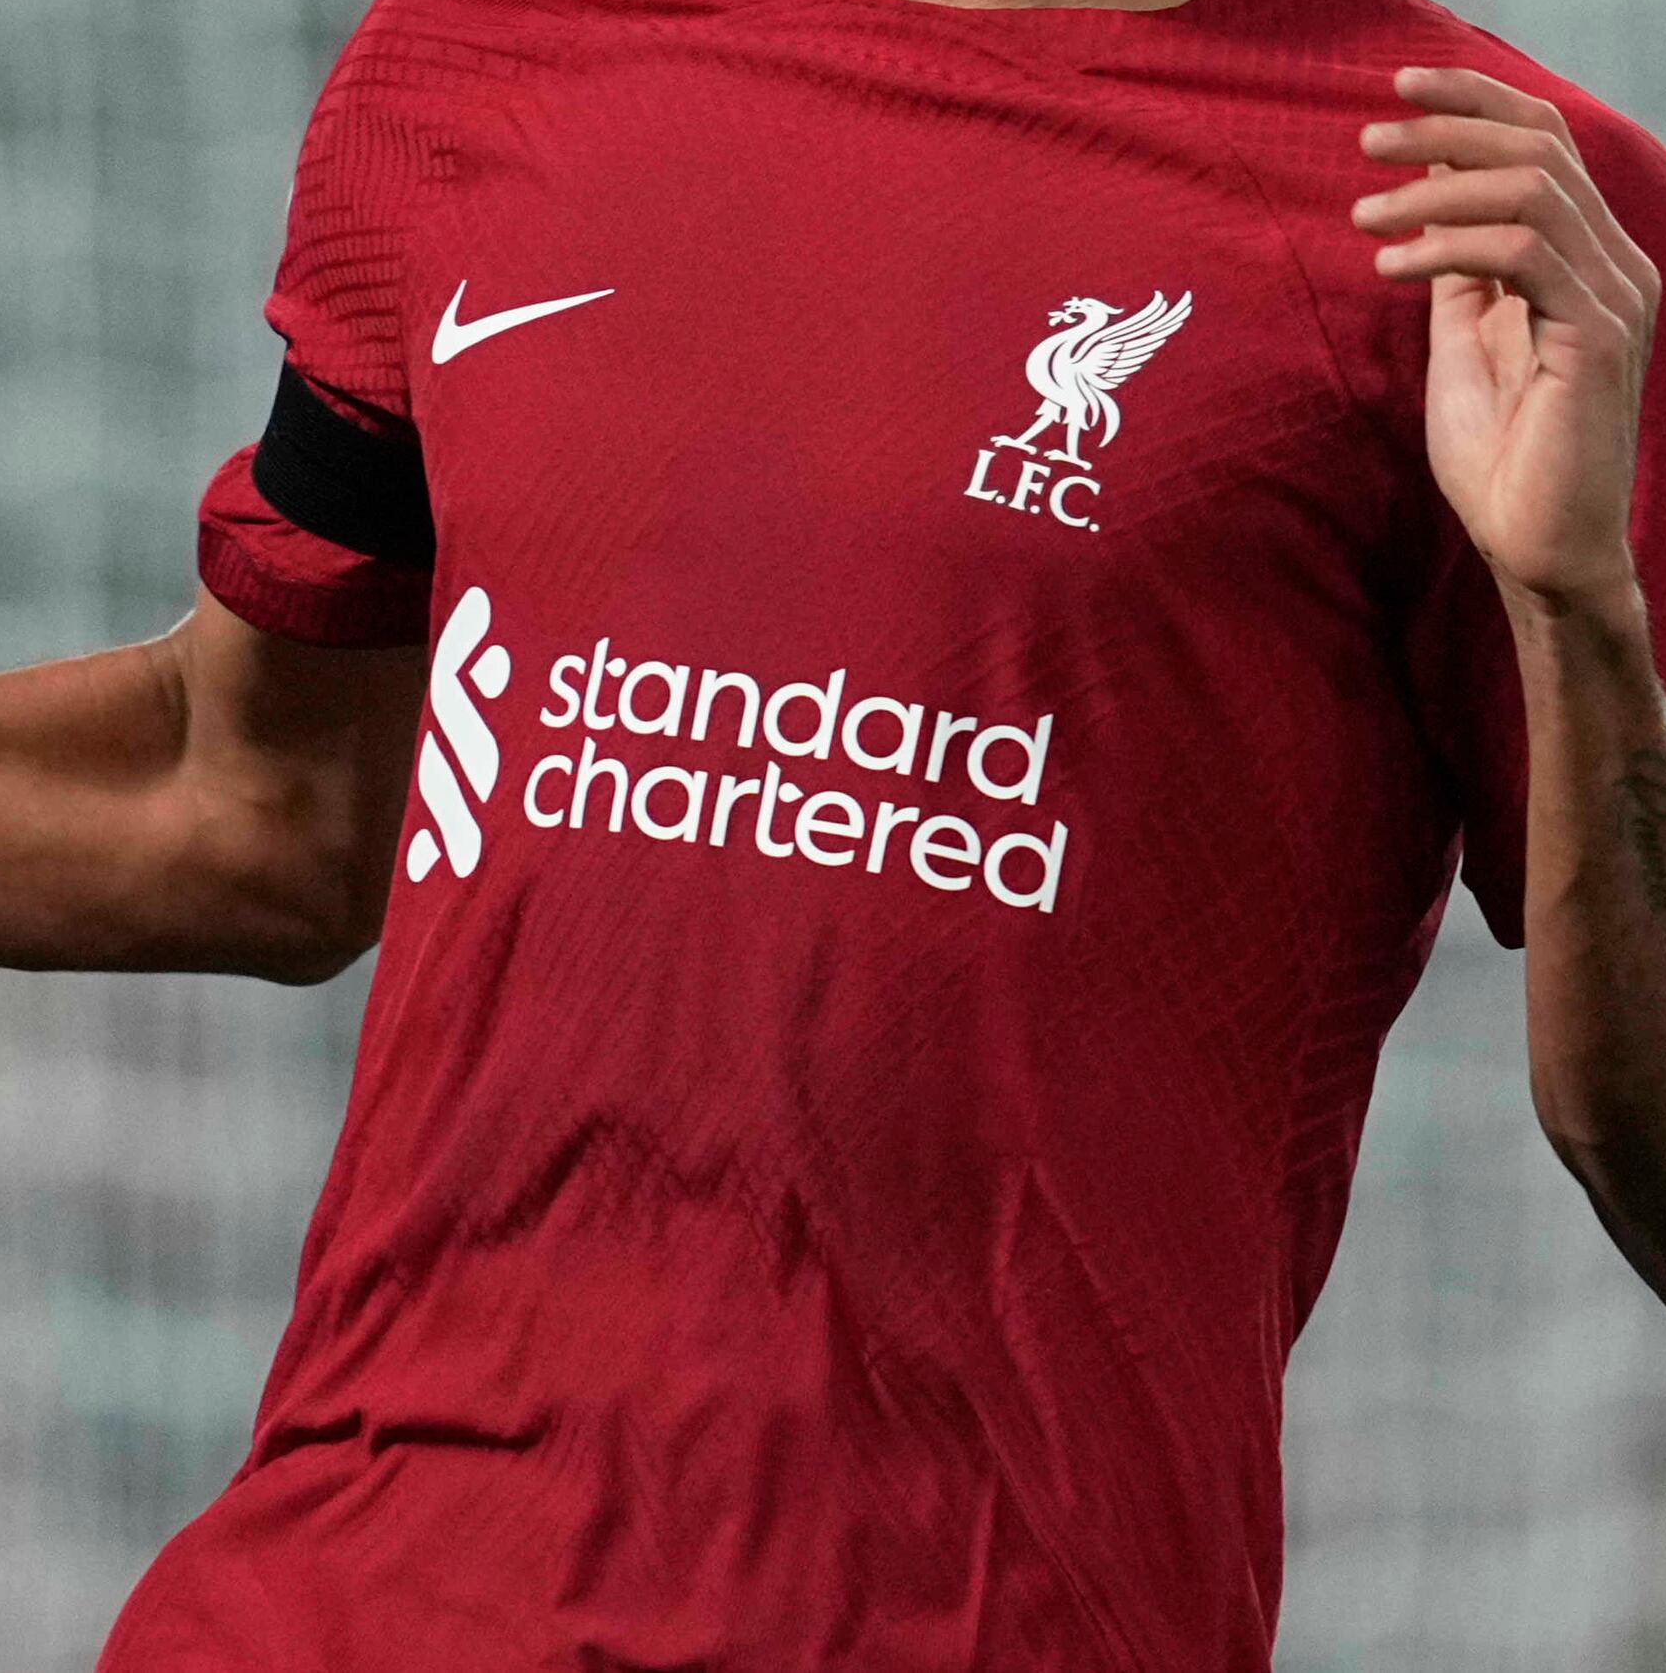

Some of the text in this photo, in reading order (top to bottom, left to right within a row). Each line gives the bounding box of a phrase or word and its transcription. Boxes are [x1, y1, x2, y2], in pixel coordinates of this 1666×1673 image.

[963, 449, 1101, 533] L.F.C.
[539, 636, 1054, 806] standard
[523, 736, 1069, 914] chartered
